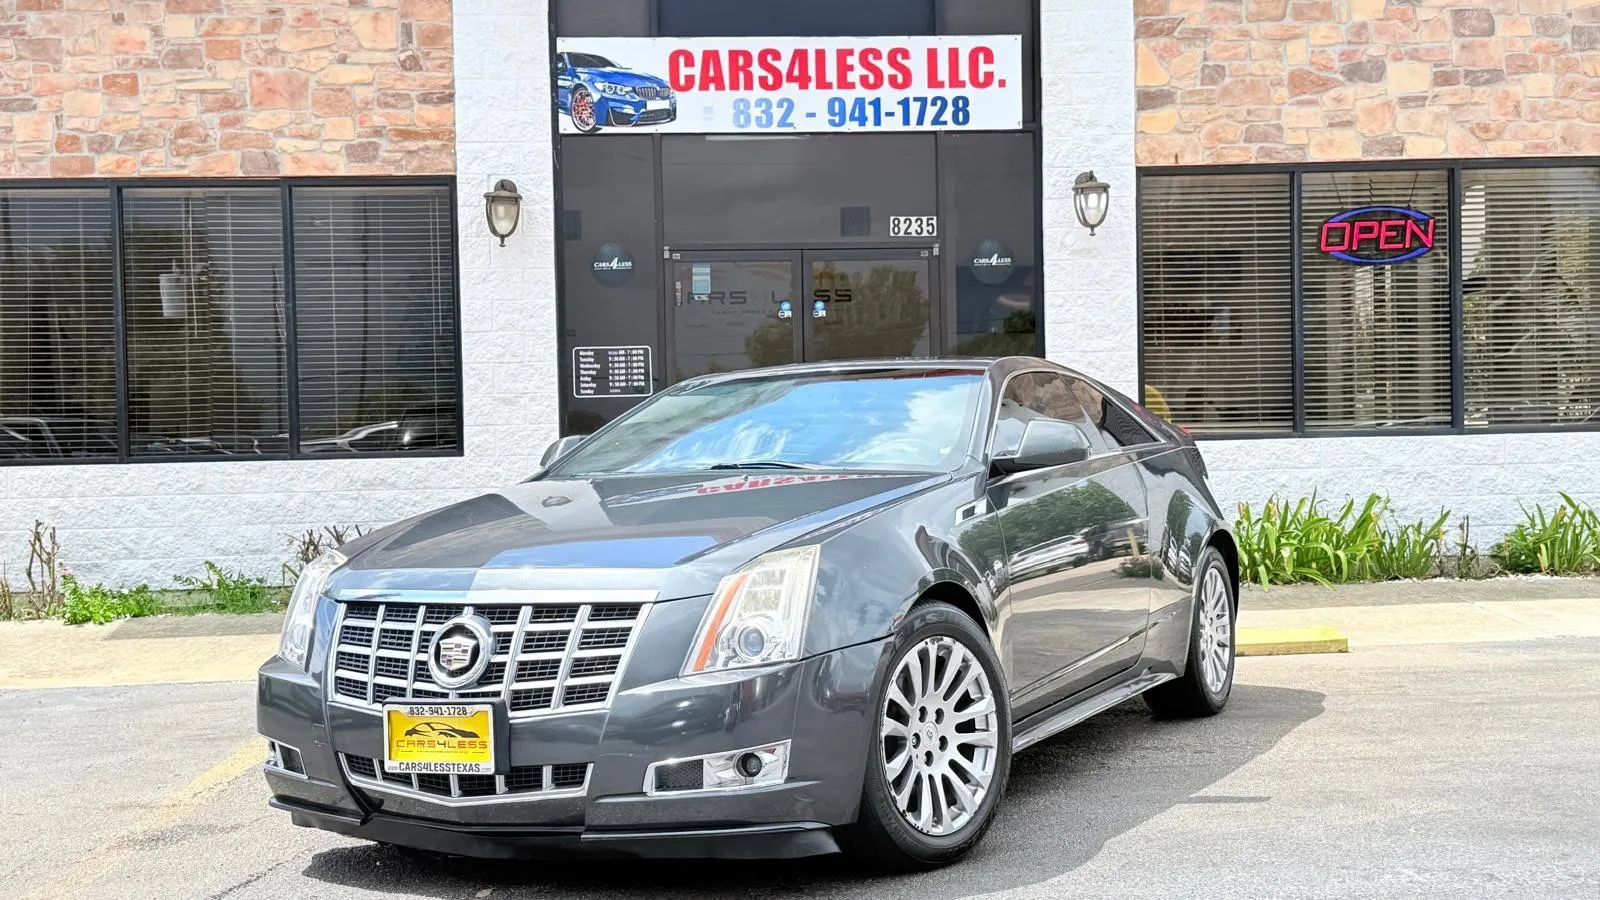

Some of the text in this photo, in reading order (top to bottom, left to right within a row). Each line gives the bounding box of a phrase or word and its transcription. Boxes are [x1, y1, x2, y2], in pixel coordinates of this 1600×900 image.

[668, 46, 1007, 92] CARS4LESS LLC.
[732, 97, 796, 129] 832
[827, 95, 971, 127] 941-1728
[892, 217, 936, 236] 8235
[1320, 218, 1436, 252] OPEN
[408, 706, 468, 716] 832-941-1728
[396, 739, 488, 749] CARS4LESS
